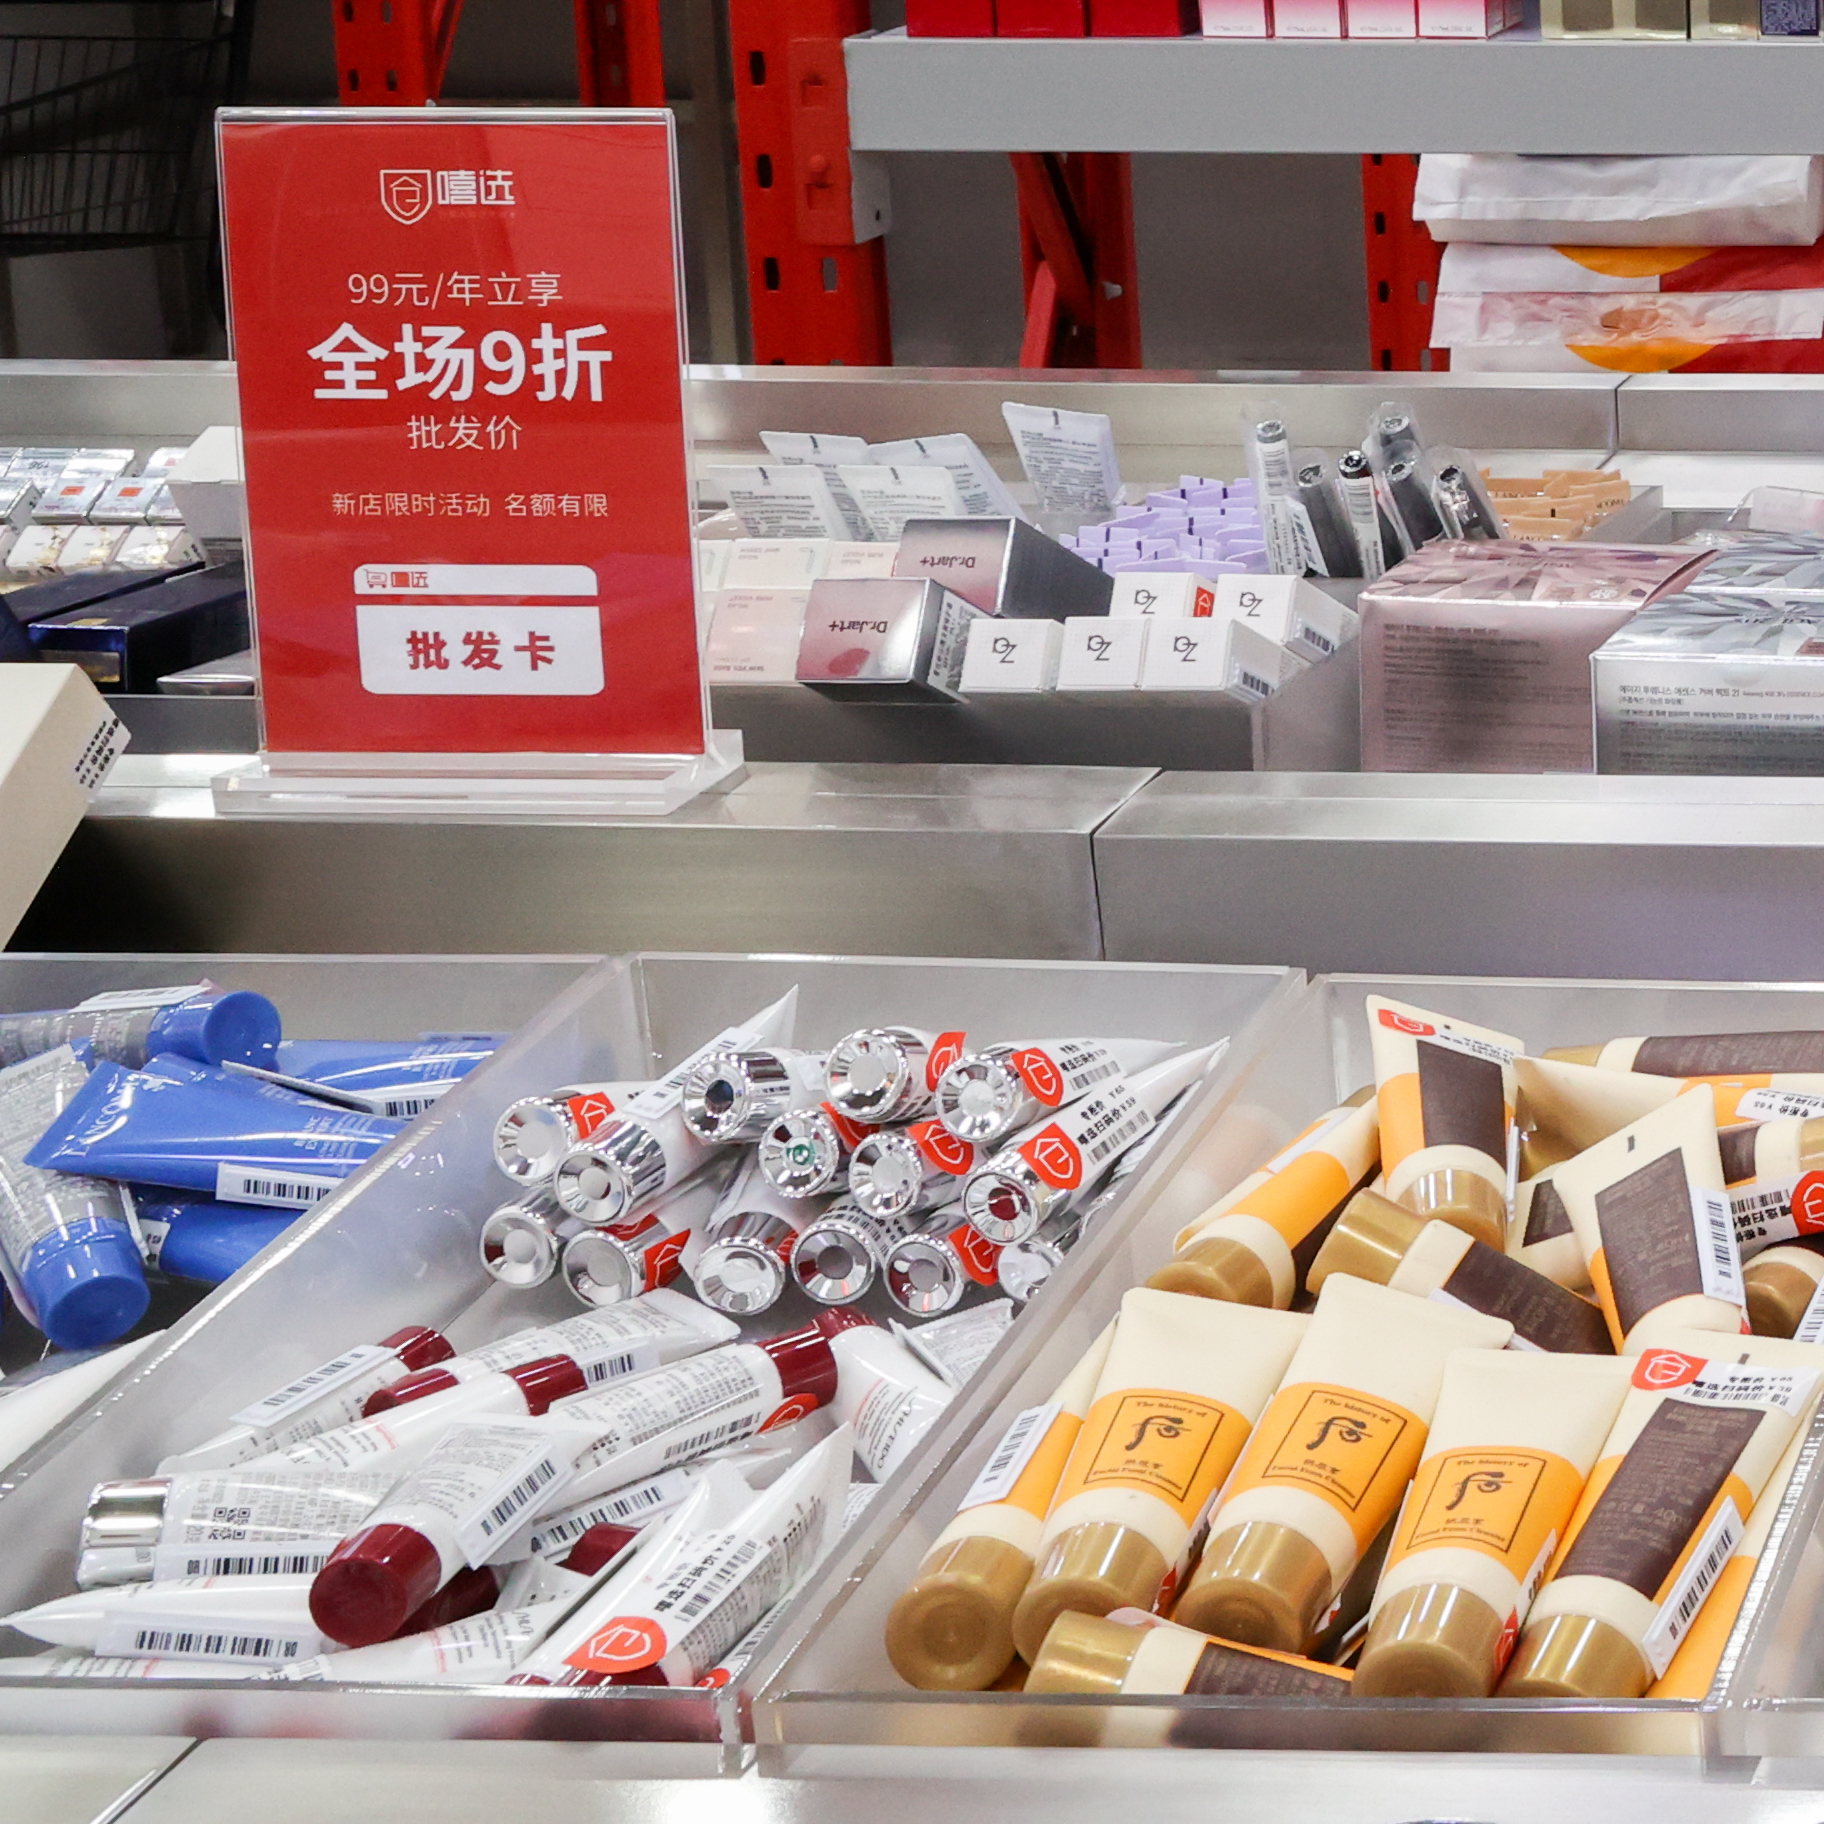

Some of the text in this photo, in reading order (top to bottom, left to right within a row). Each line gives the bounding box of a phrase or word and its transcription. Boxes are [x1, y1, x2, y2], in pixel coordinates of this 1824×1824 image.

[437, 169, 515, 206] 嘻选
[347, 271, 563, 310] 99元/年立享
[307, 322, 612, 402] 全场9折
[406, 415, 522, 451] 批发价
[331, 492, 609, 518] 新店限时活动 名额有限
[919, 556, 976, 569] Dr.Jart+
[828, 620, 888, 634] Dr.Jart+
[405, 630, 556, 671] 批发卡
